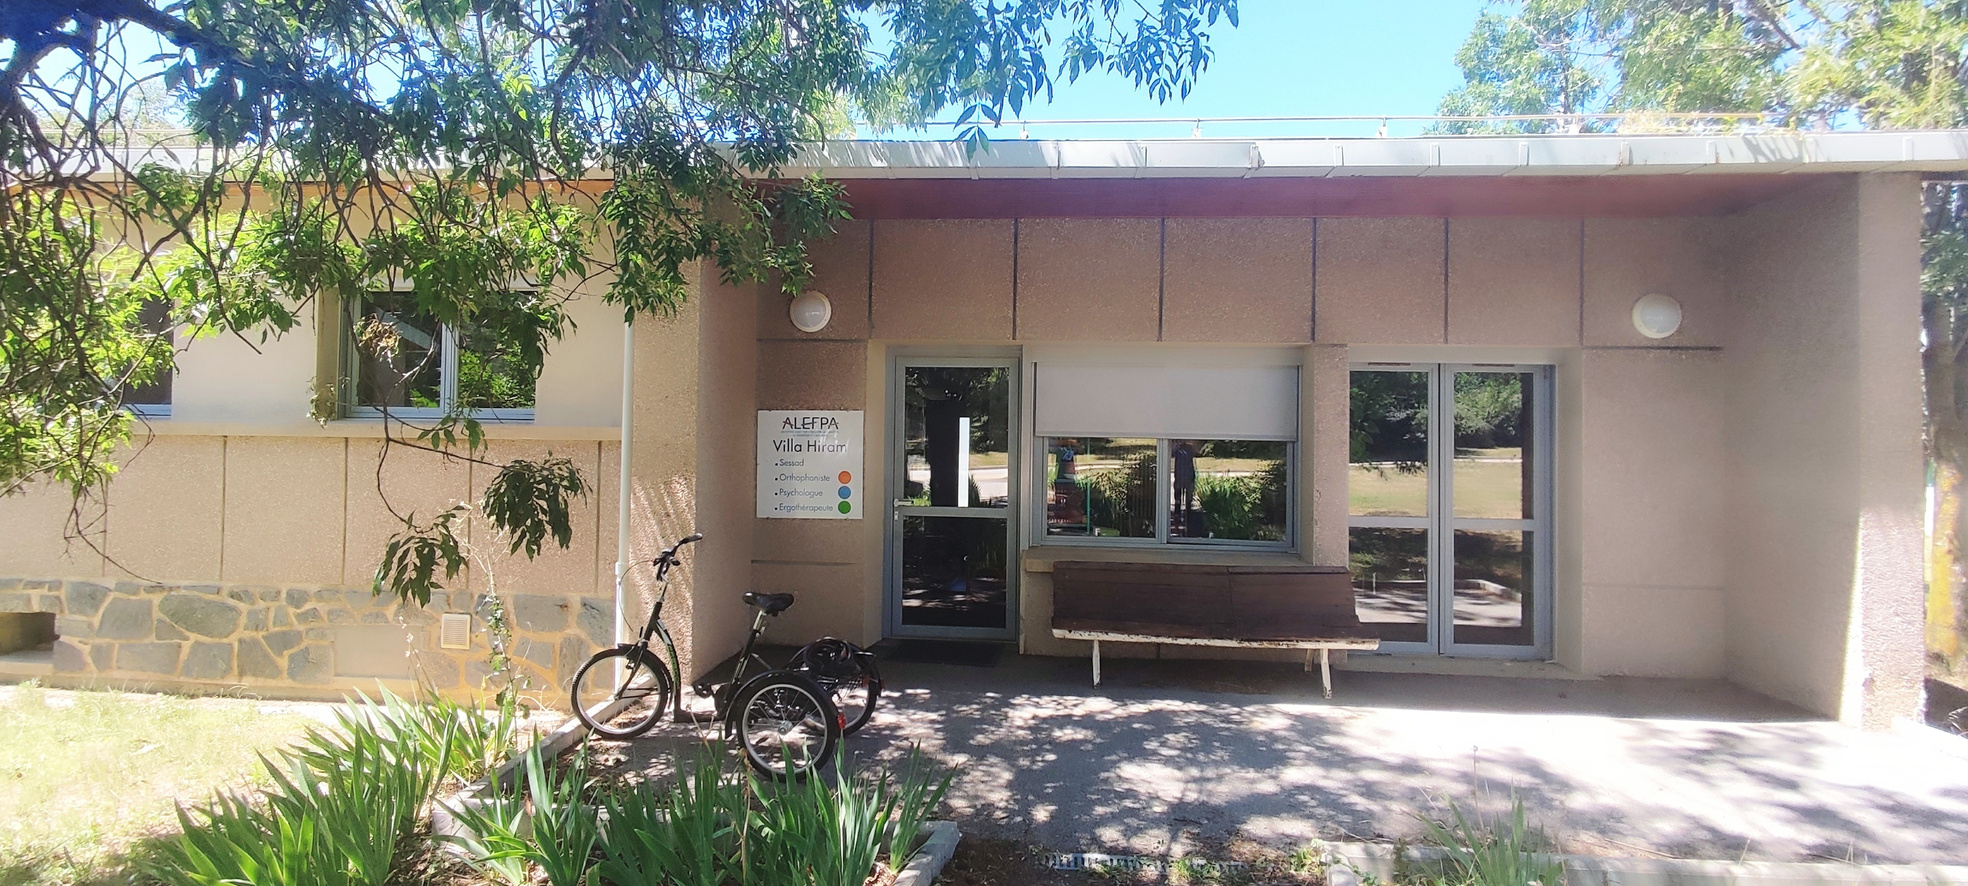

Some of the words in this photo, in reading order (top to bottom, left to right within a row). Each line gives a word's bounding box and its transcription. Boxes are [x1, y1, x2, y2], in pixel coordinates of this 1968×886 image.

[782, 416, 839, 430] ALEFPA
[773, 438, 802, 452] Villa
[807, 439, 847, 452] Hiram
[779, 458, 805, 467] Sessad
[779, 473, 830, 483] Orthophoniste
[779, 488, 824, 498] Psychologue
[779, 502, 834, 513] Ergothérapeute
